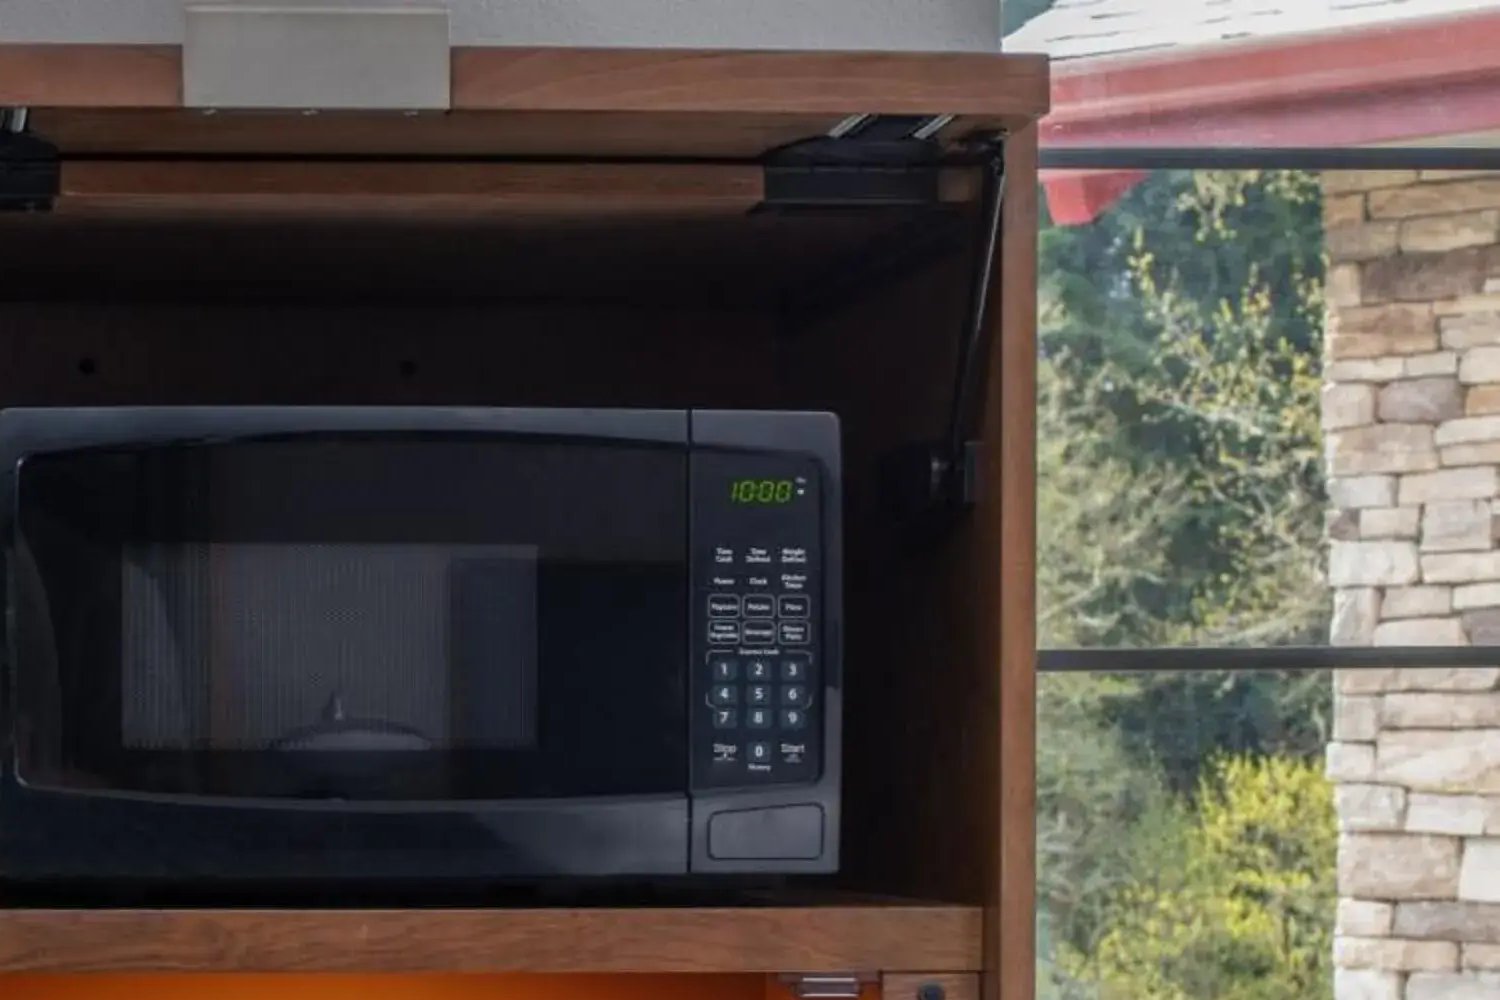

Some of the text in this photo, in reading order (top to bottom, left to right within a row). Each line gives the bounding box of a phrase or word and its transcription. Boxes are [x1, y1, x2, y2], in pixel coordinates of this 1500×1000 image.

[721, 662, 728, 676] 1
[755, 662, 764, 676] 2
[789, 662, 798, 676] 3
[720, 686, 729, 699] 4
[755, 686, 764, 700] 5
[788, 687, 798, 701] 6
[720, 710, 729, 724] 7
[754, 744, 764, 758] 0
